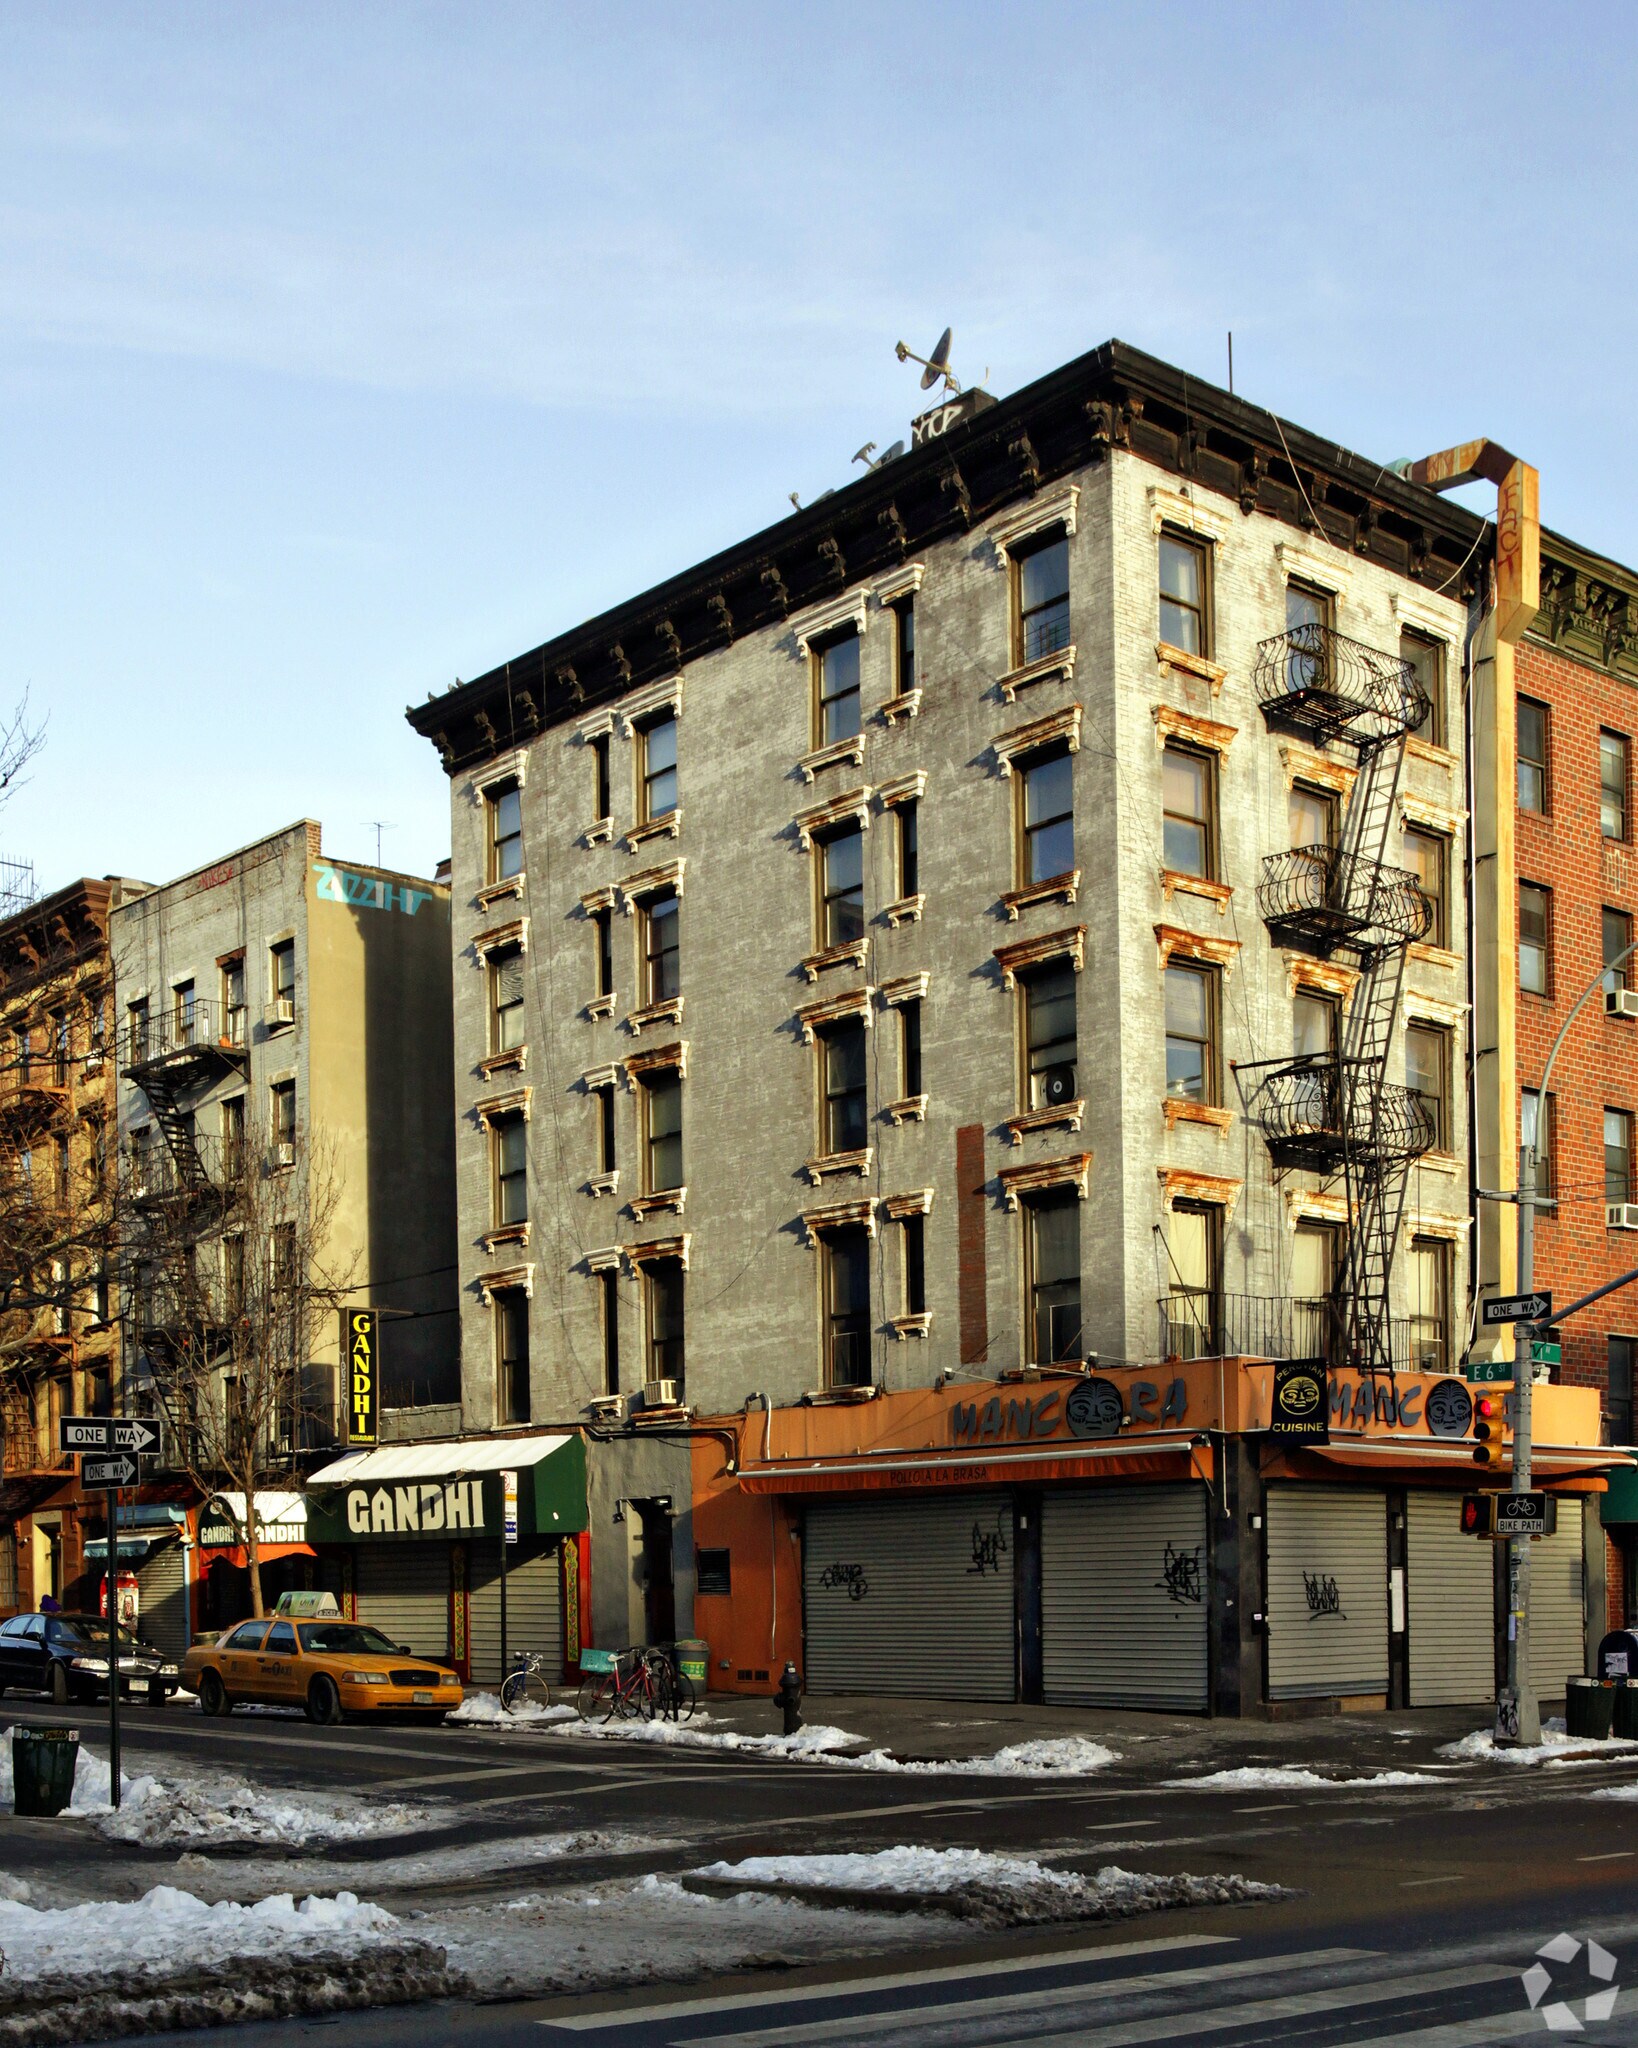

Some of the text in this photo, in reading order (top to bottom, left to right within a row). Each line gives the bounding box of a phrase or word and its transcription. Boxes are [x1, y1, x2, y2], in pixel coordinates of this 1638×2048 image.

[1493, 1301, 1541, 1316] ONE WAY
[352, 1314, 371, 1434] GANDHI
[1474, 1364, 1506, 1380] E 6 ST
[75, 1428, 145, 1443] ONE WAY
[1272, 1422, 1324, 1433] CUISINE
[89, 1463, 130, 1479] ONE WAY
[889, 1466, 987, 1484] POLLO A LA BRASA
[347, 1480, 485, 1534] GANDHI
[1500, 1520, 1542, 1530] BIKE PATH
